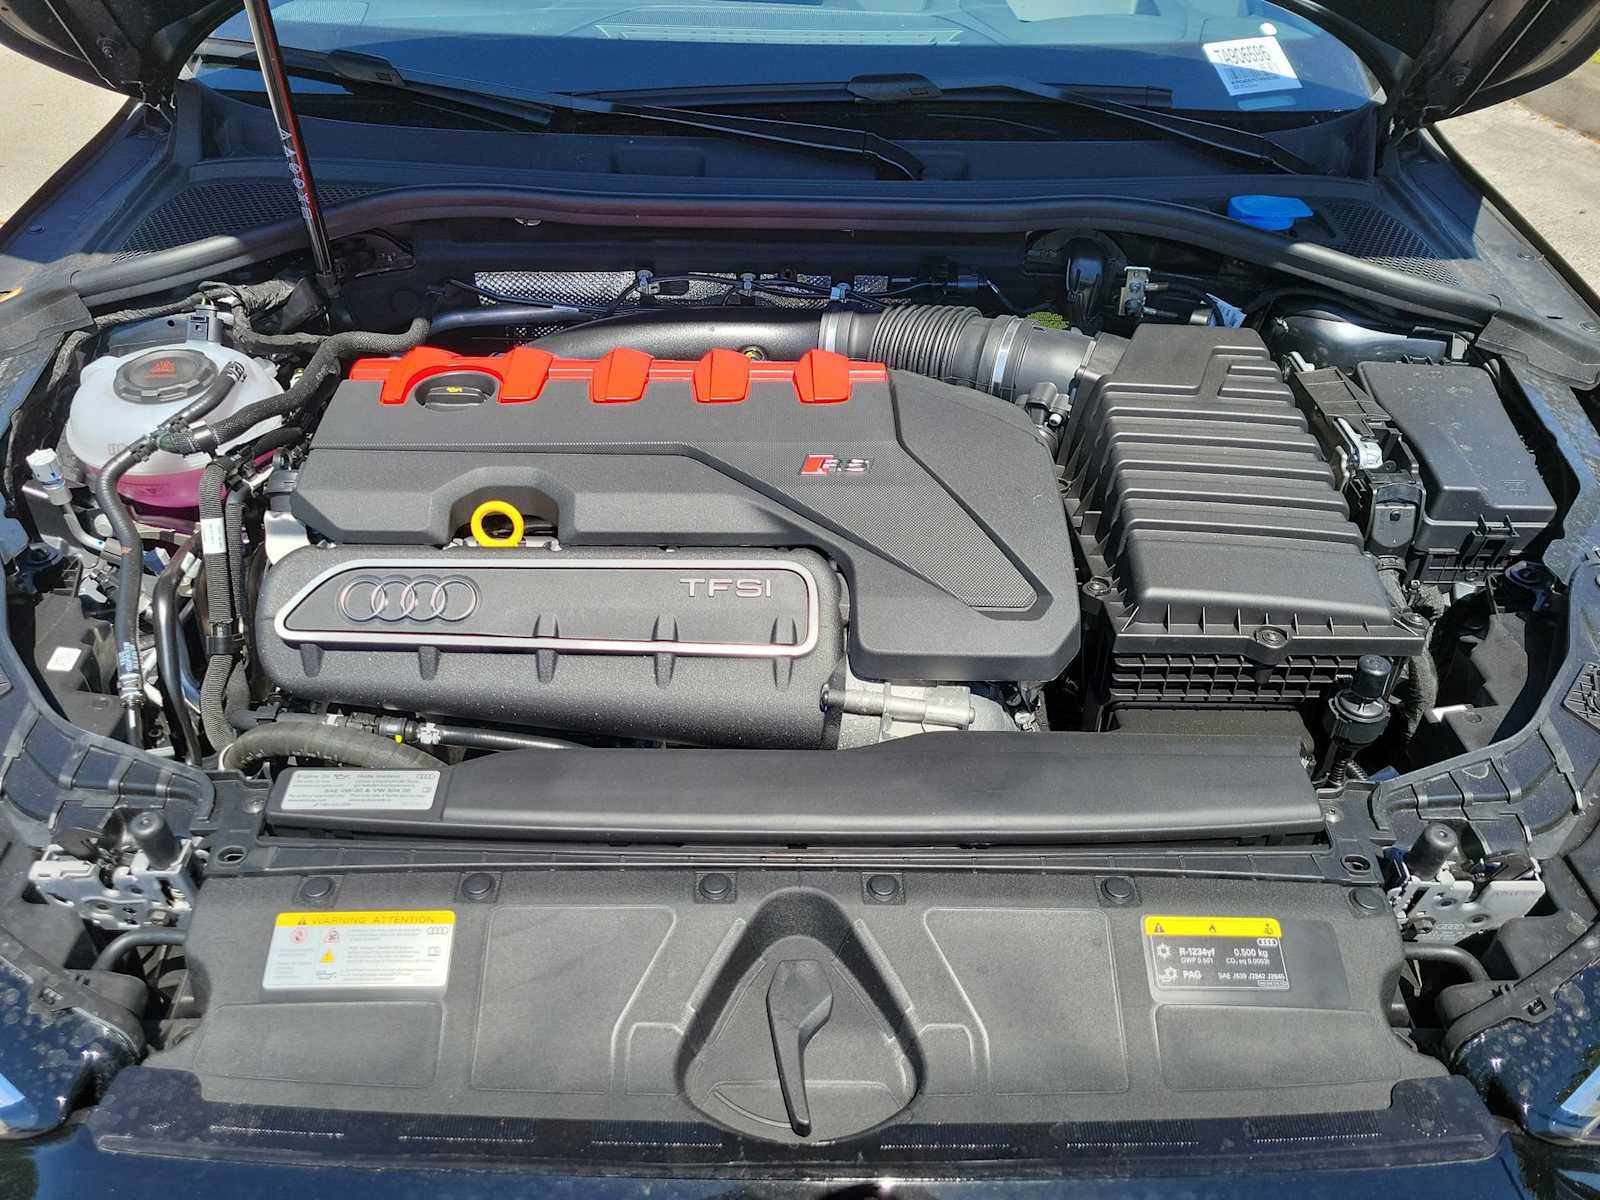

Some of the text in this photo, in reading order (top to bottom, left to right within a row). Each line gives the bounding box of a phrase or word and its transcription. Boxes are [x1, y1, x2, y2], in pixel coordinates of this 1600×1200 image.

[679, 577, 773, 598] TFSI
[312, 914, 435, 925] WARNING ATTENTION
[1179, 947, 1269, 959] R-1234yf 0.500 kg
[1217, 972, 1231, 980] SAE
